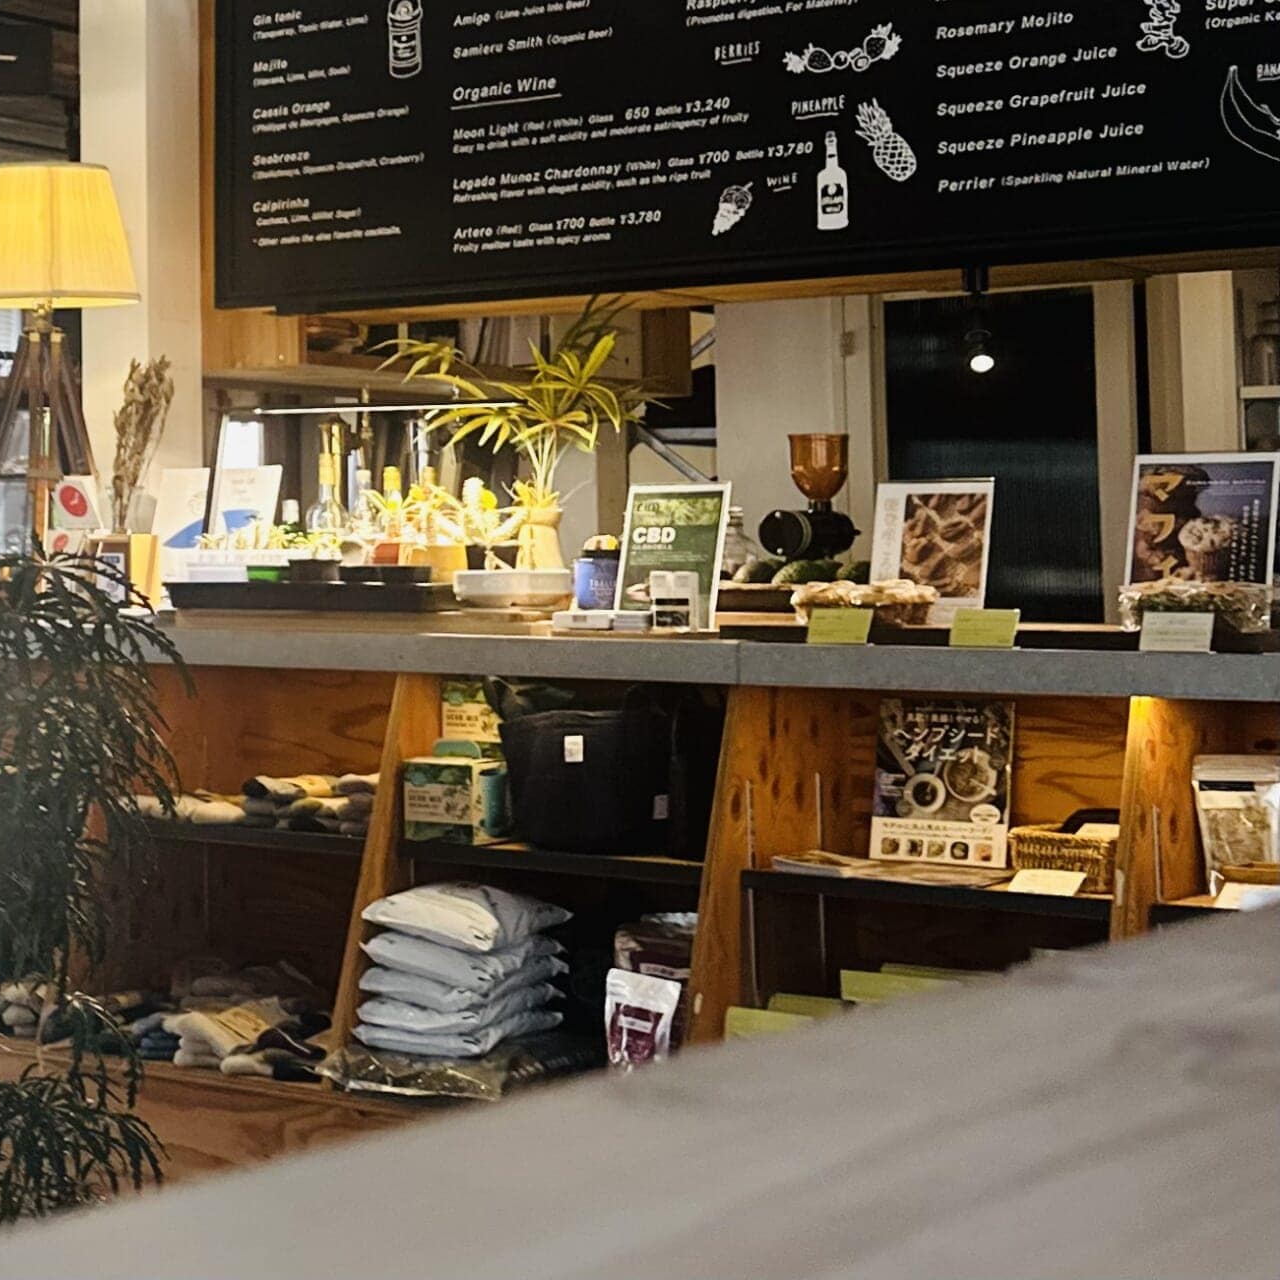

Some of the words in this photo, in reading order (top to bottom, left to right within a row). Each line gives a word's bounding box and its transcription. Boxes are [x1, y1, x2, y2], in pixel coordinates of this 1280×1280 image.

[252, 14, 272, 26] Gin
[452, 12, 491, 27] Amigo
[521, 5, 545, 16] Juice
[935, 20, 1015, 40] Rosemary
[1020, 11, 1074, 29] Mojito
[1204, 13, 1261, 30] (Organic
[506, 35, 543, 51] Smith
[546, 31, 586, 45] (Organic
[587, 26, 613, 40] Beer)
[714, 40, 760, 61] BERRIES
[252, 58, 288, 73] Mojito
[935, 60, 1003, 79] Squeeze
[1008, 52, 1067, 69] Orange
[1072, 46, 1118, 62] Juice
[452, 81, 512, 102] Organic
[517, 76, 557, 92] Wine
[936, 99, 1004, 117] Squeeze
[1009, 87, 1095, 108] Grapefruit
[1100, 82, 1146, 98] Juice
[291, 100, 331, 115] Orange
[791, 94, 845, 115] PINEAPPLE
[452, 127, 485, 140] Moon
[488, 121, 519, 137] Light
[624, 105, 650, 120] 650
[937, 138, 1004, 155] Squeeze
[1009, 126, 1093, 147] Pineapple
[1099, 122, 1144, 138] Juice
[252, 151, 310, 166] Seabreeze
[452, 175, 496, 191] Legado
[543, 163, 622, 181] Chardonnay
[766, 172, 797, 188] WINE
[937, 176, 996, 193] Perrier
[1066, 166, 1112, 180] Natural
[1115, 161, 1163, 176] Mineral
[1166, 157, 1210, 171] Water)
[453, 226, 493, 239] Artero
[632, 526, 677, 544] CBD
[893, 724, 999, 745] ヘンプシード
[904, 741, 982, 764] ダイエット
